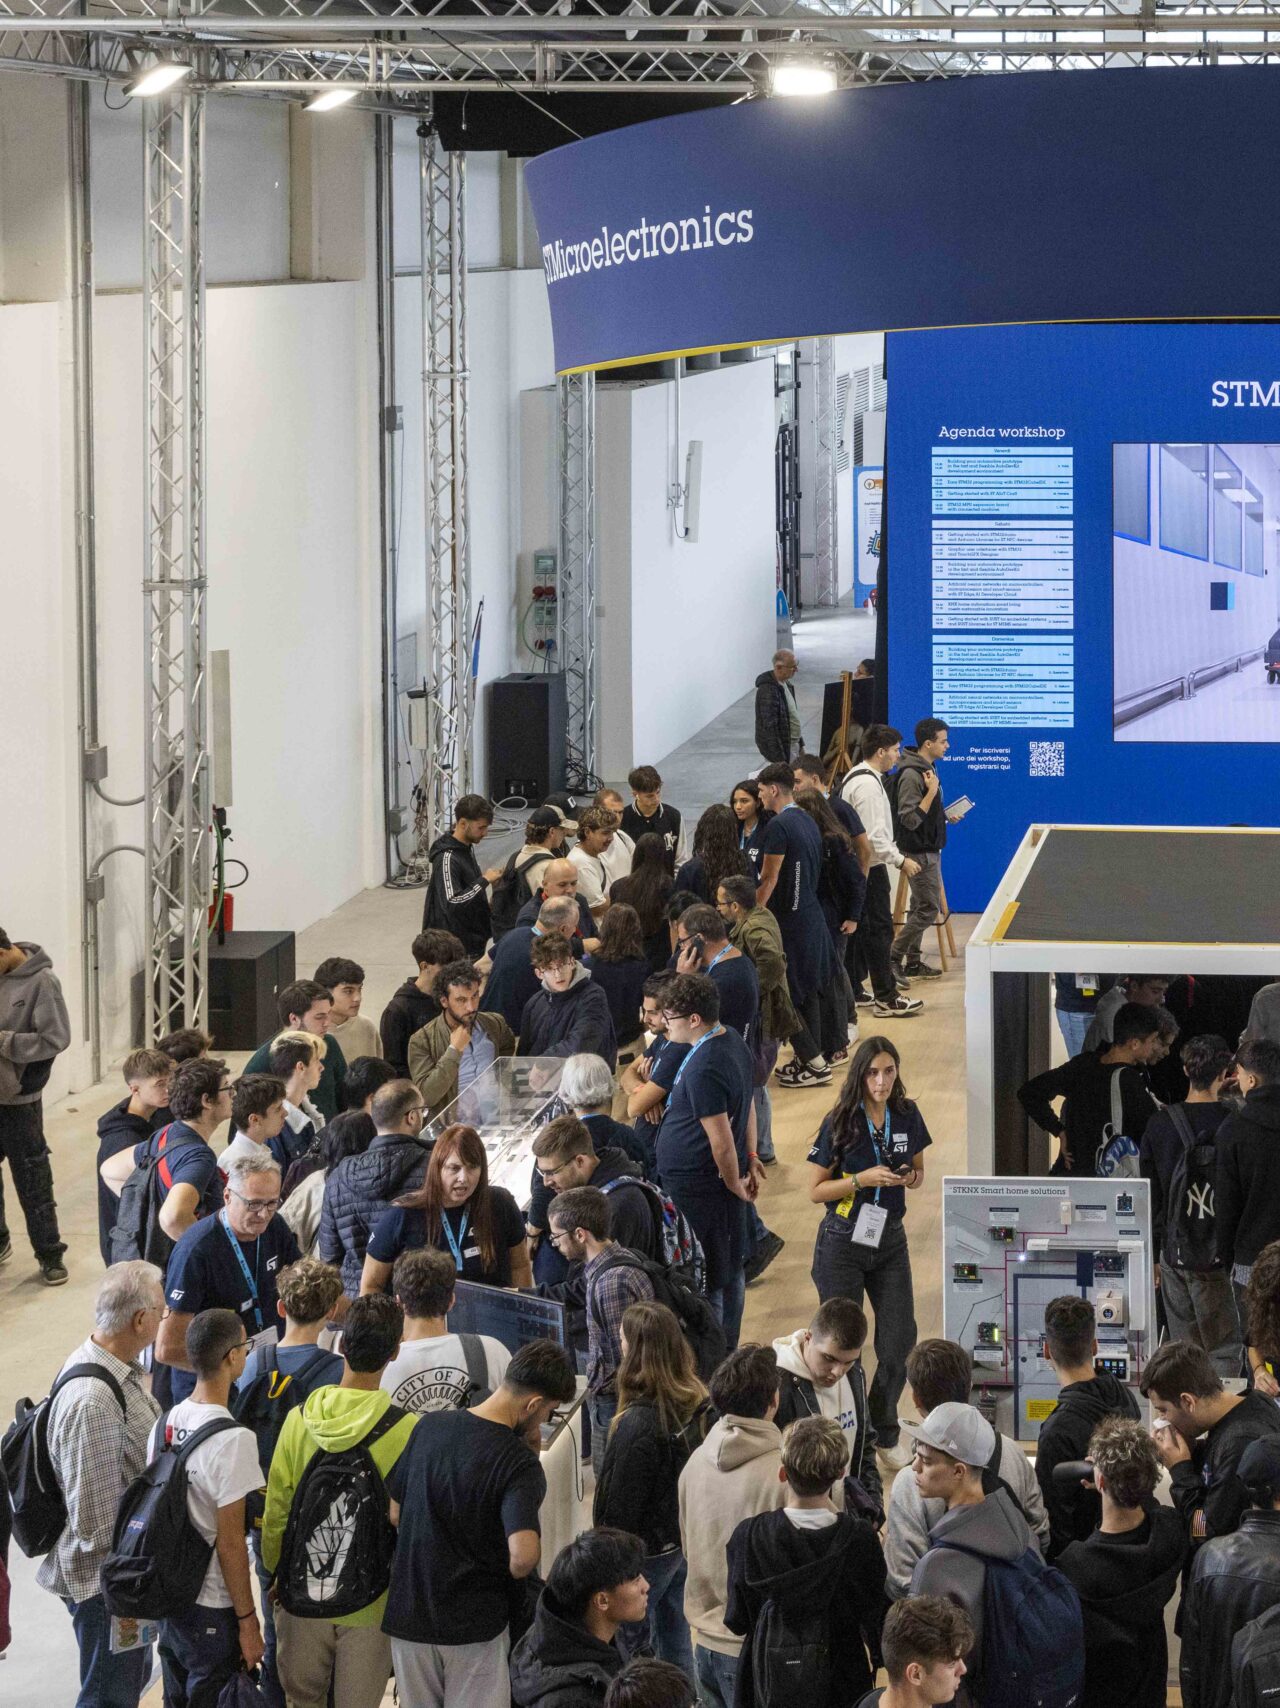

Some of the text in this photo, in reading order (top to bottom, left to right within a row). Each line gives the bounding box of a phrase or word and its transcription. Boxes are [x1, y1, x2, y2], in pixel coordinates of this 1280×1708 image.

[542, 205, 754, 285] STMicroelectronics
[939, 426, 1066, 440] Agenda workshop
[977, 755, 1011, 763] workshop,
[967, 763, 1011, 771] registrarsi qui
[893, 1142, 908, 1153] ST
[952, 1186, 1066, 1196] STKNX Smart home solutions
[1187, 1182, 1216, 1219] NY
[397, 1374, 425, 1402] CITY
[434, 1370, 453, 1382] OF
